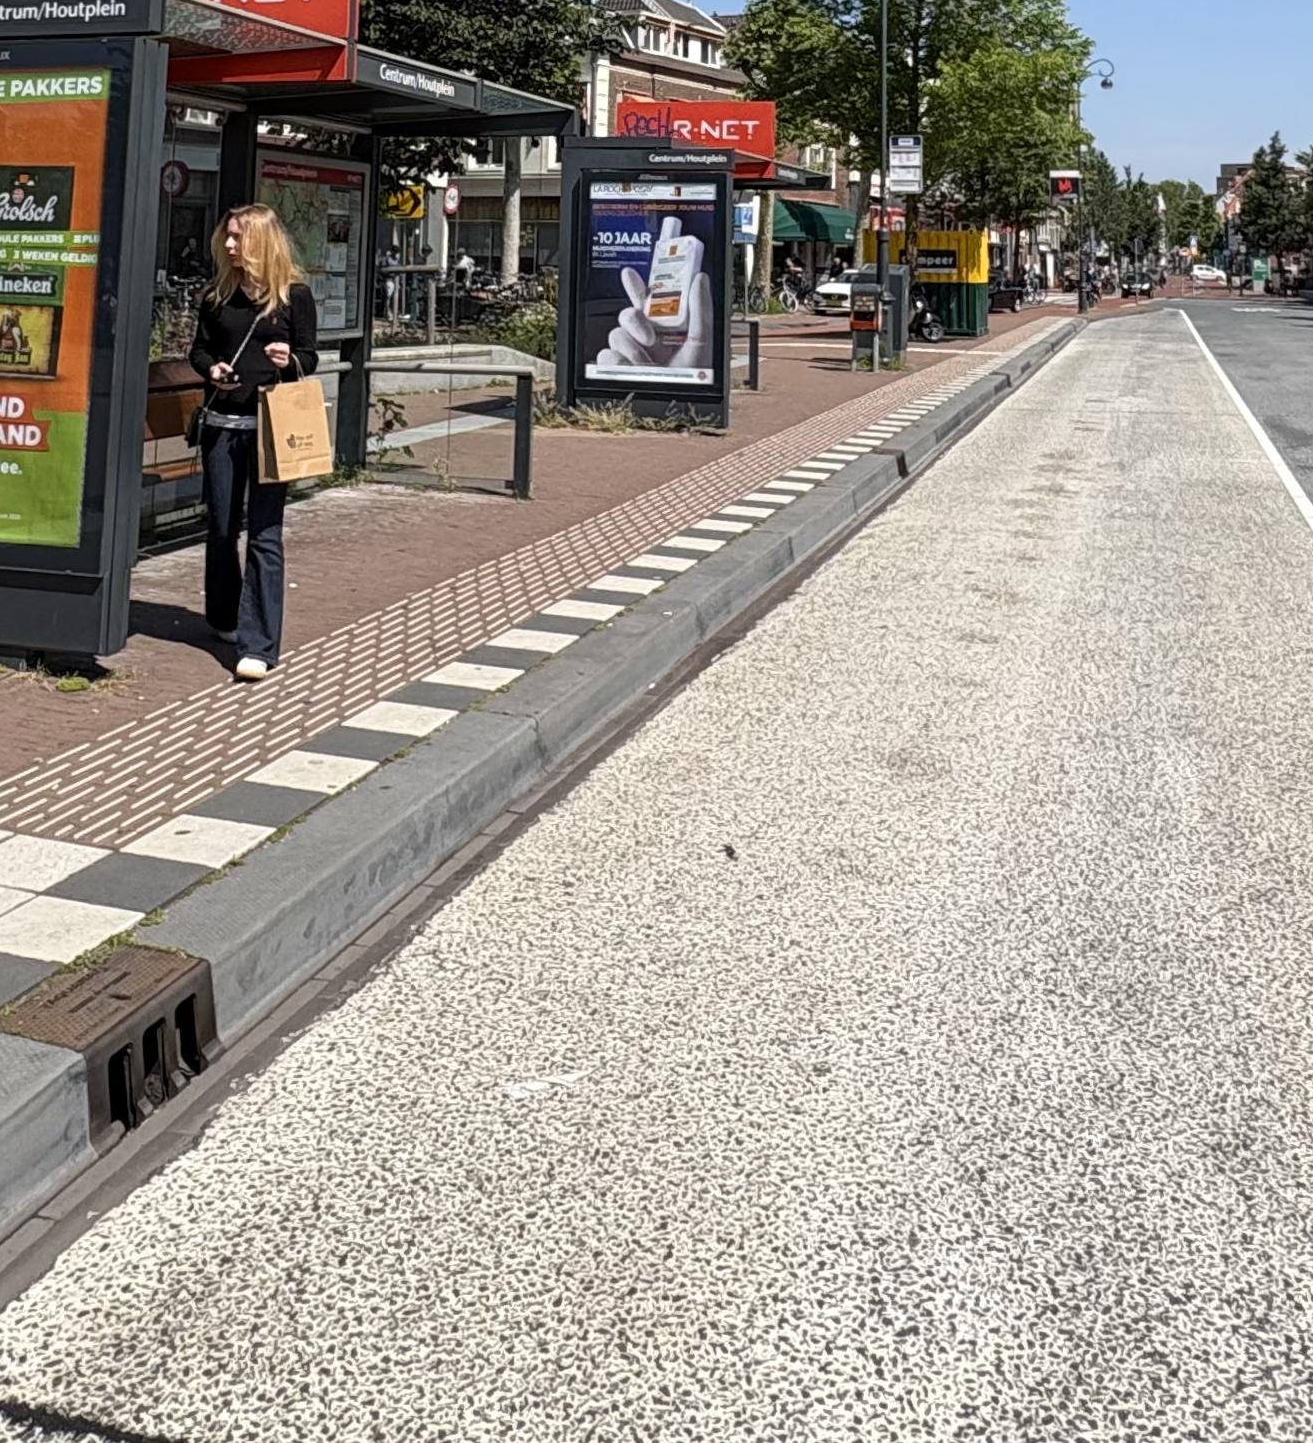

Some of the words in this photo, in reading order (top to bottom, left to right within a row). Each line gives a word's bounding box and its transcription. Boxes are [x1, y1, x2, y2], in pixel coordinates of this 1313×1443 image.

[10, 76, 103, 97] PAKKERS
[592, 231, 613, 244] -10
[615, 231, 652, 244] JAAR
